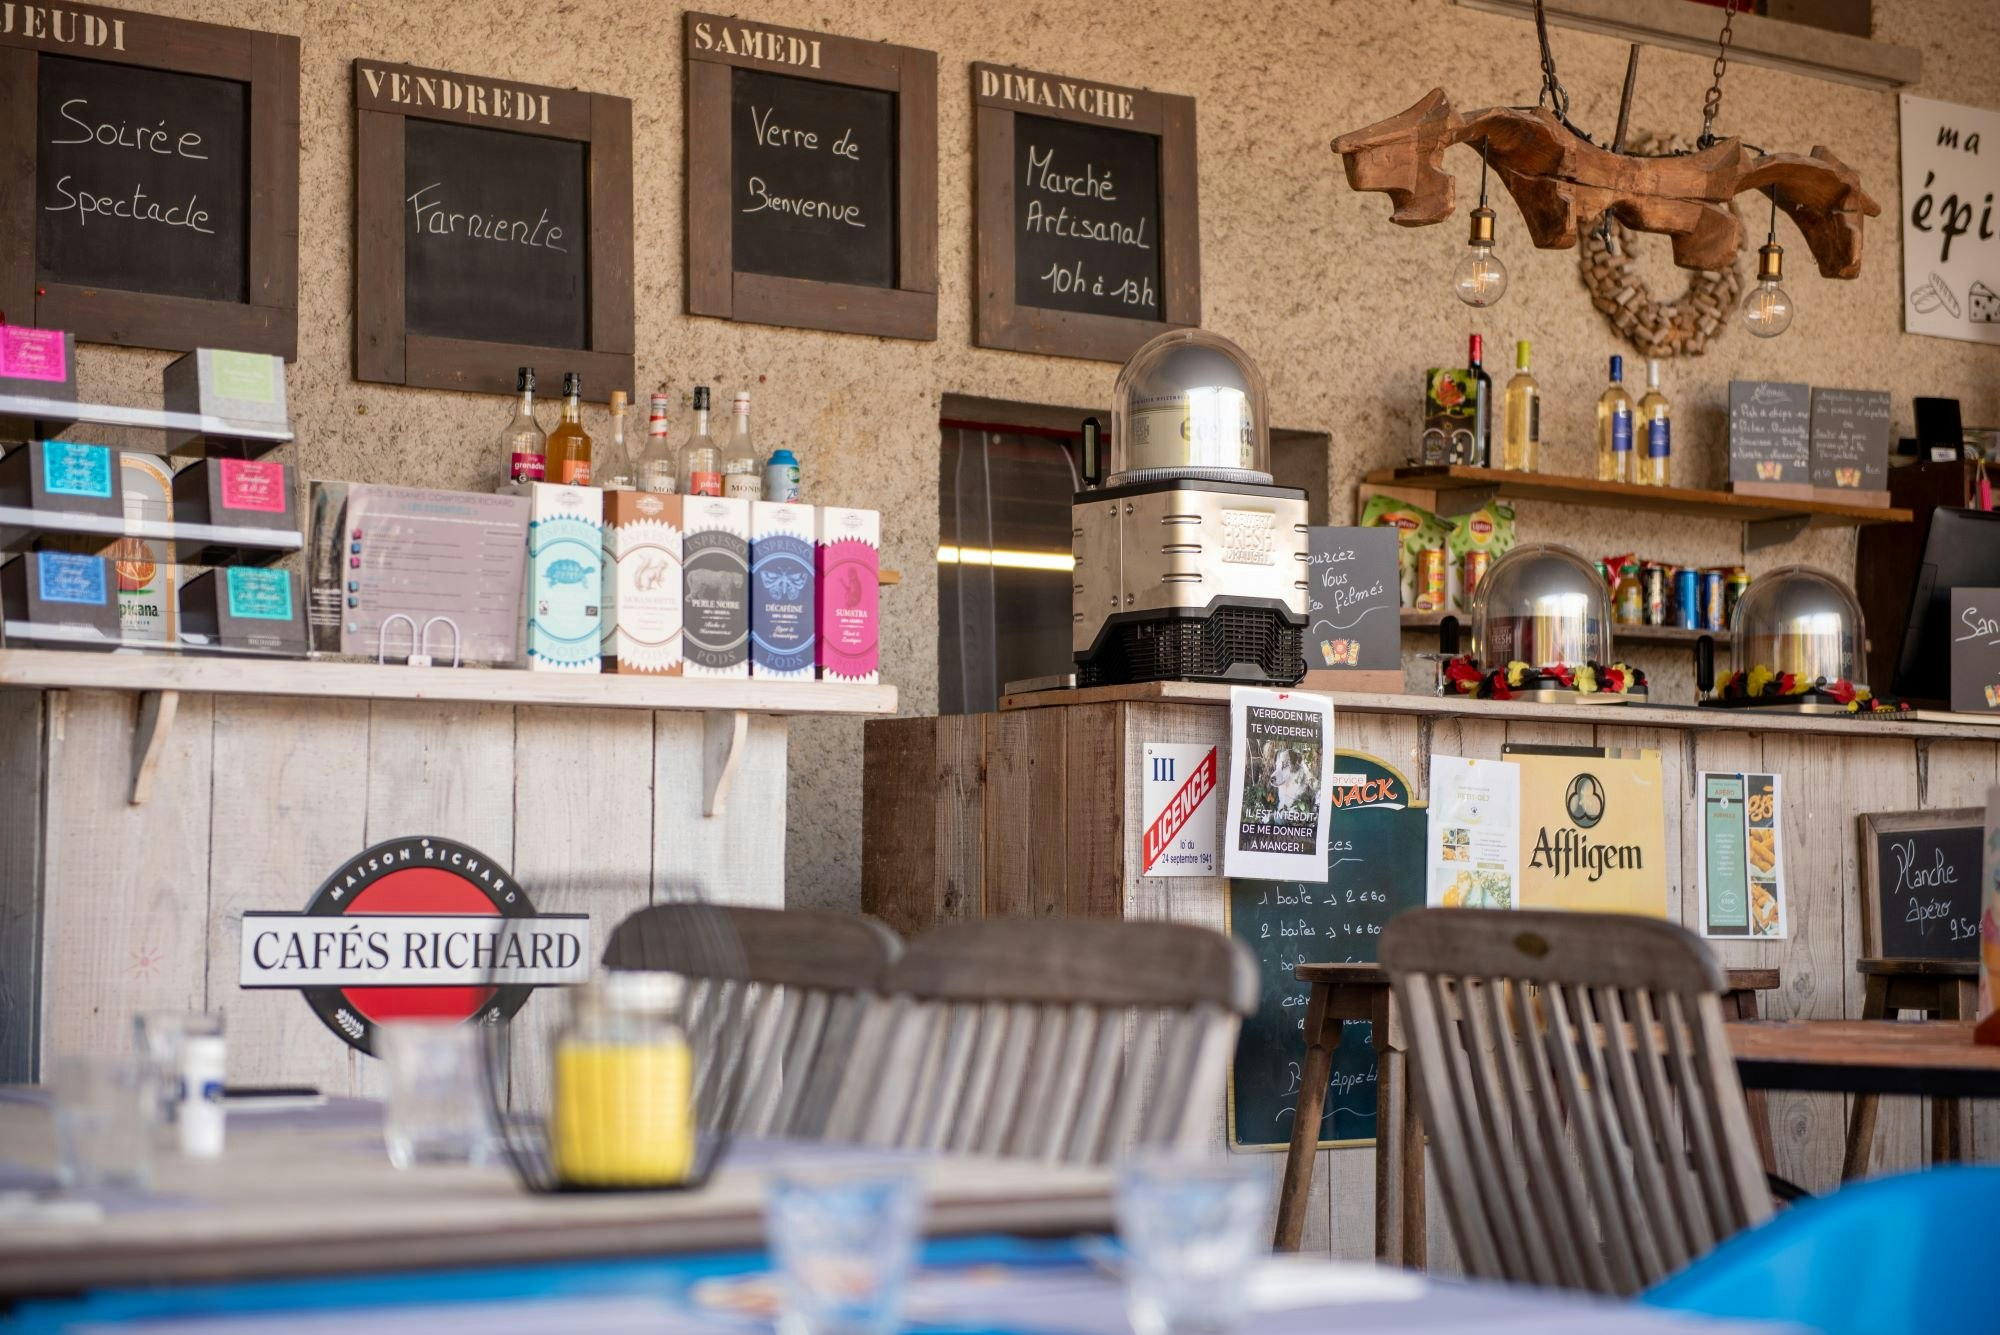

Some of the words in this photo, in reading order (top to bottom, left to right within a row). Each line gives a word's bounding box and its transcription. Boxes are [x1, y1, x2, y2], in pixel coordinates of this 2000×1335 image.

[0, 3, 126, 51] JEUDI
[694, 22, 822, 70] SAMEDI
[363, 69, 552, 126] VENDREDI
[981, 70, 1134, 121] DIMANCHE
[51, 99, 208, 160] Soirée
[751, 106, 819, 151] Verre
[831, 129, 860, 161] de
[1936, 125, 1981, 156] ma
[1026, 145, 1117, 202] Marché
[45, 175, 215, 235] Spectacle
[407, 182, 568, 254] Farniente
[742, 177, 867, 228] Bienvenue
[1910, 170, 2000, 264] épi
[1026, 201, 1151, 250] Artisanal
[1041, 260, 1086, 296] 10h
[1109, 276, 1156, 307] 13h
[1222, 527, 1274, 552] FRESH
[1471, 522, 1492, 531] Lipton
[685, 534, 746, 556] ESPRESSO
[1322, 567, 1348, 587] Vous
[691, 599, 715, 608] PERLE
[716, 600, 741, 609] NOIRE
[835, 608, 868, 618] SUMATRA
[1334, 579, 1384, 615] filmés
[1955, 606, 1999, 642] San
[697, 650, 736, 665] PODS
[766, 652, 804, 668] PODS
[1251, 724, 1262, 734] TE
[1264, 725, 1314, 738] VOEDEREN
[1253, 708, 1303, 721] VERBODEN
[1152, 758, 1175, 781] III
[1150, 759, 1209, 861] LICENCE
[1246, 808, 1254, 818] IL
[1255, 809, 1273, 819] EST
[1274, 811, 1315, 822] INTERDIT
[1188, 841, 1195, 850] du
[1242, 824, 1255, 834] DE
[1257, 825, 1271, 835] ME
[1273, 826, 1313, 838] DONNER
[1260, 842, 1300, 852] MANGER
[1162, 854, 1168, 863] 24
[1170, 854, 1198, 866] septembre
[1200, 855, 1212, 864] 1941
[1528, 826, 1643, 882] Affligem
[1890, 838, 1959, 894] Planche
[330, 847, 411, 902] MAISON
[424, 847, 516, 904] RICHARD
[1276, 883, 1313, 905] boule
[1261, 923, 1271, 938] 2
[1281, 918, 1316, 936] boules
[253, 924, 390, 970] CAFÉS
[402, 931, 581, 969] RICHARD
